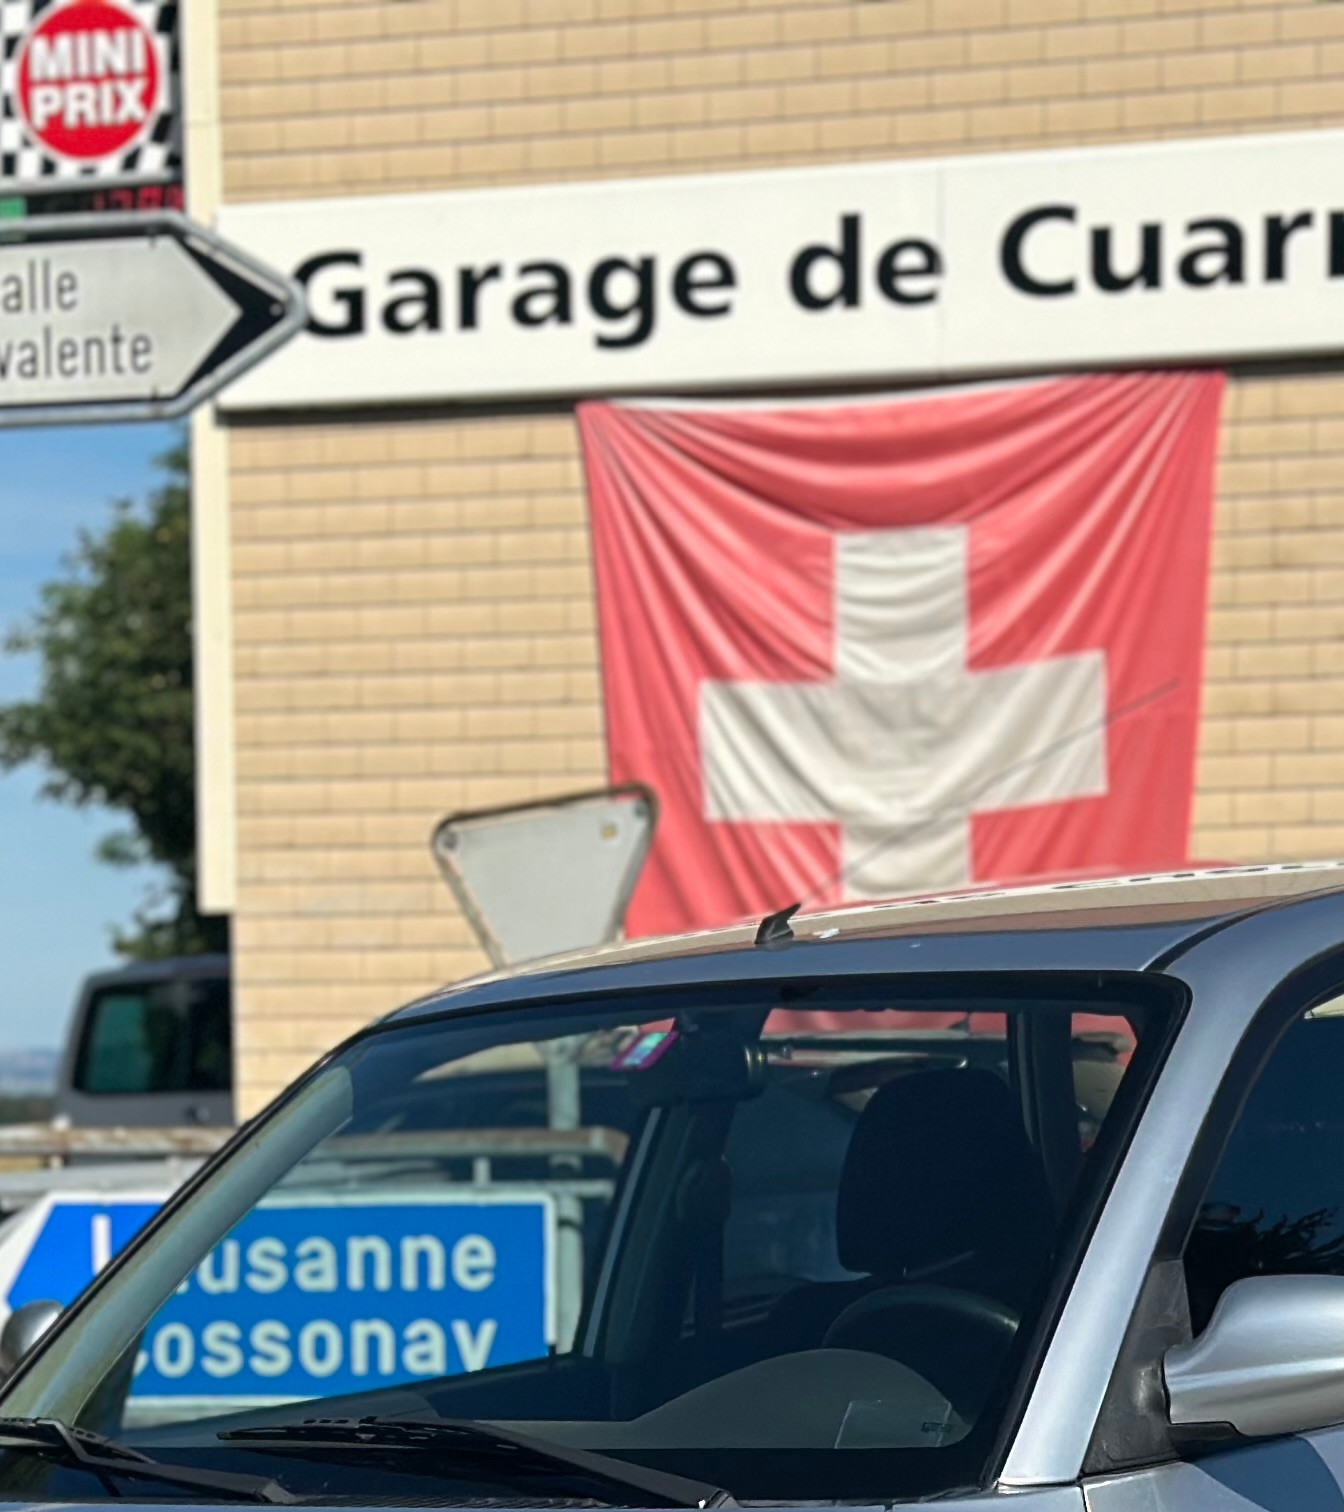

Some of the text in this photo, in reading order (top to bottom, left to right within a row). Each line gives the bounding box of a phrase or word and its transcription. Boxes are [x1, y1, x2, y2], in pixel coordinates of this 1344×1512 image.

[29, 29, 145, 80] MINI
[29, 79, 148, 130] PRIX
[295, 250, 737, 350] Garage
[789, 213, 943, 312] de
[133, 1319, 497, 1377] ossonay
